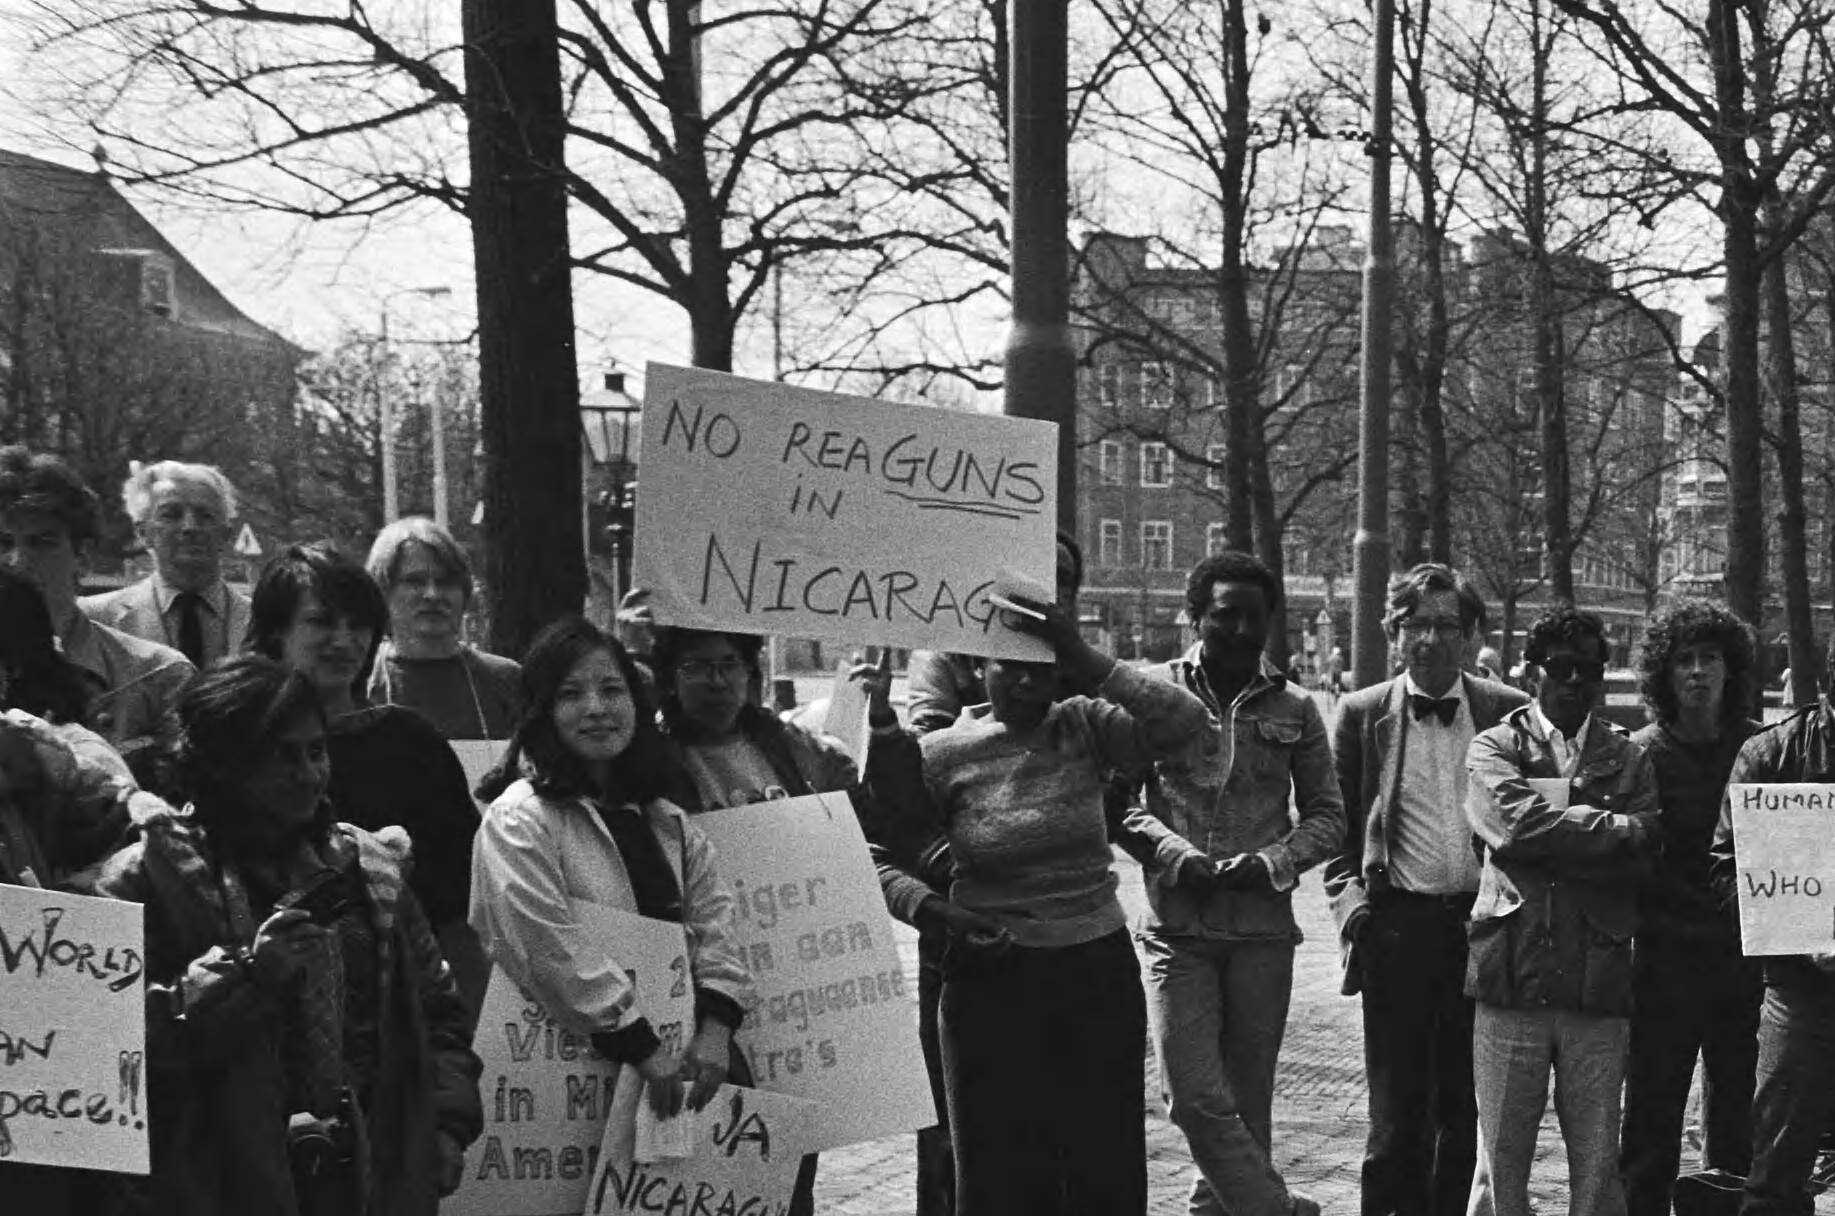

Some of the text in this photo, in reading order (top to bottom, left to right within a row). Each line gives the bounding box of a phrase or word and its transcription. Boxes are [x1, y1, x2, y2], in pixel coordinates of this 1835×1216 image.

[662, 399, 1045, 504] NO REAGUNS
[1745, 869, 1822, 899] WHO
[493, 1074, 536, 1123] in
[712, 1088, 770, 1163] JA
